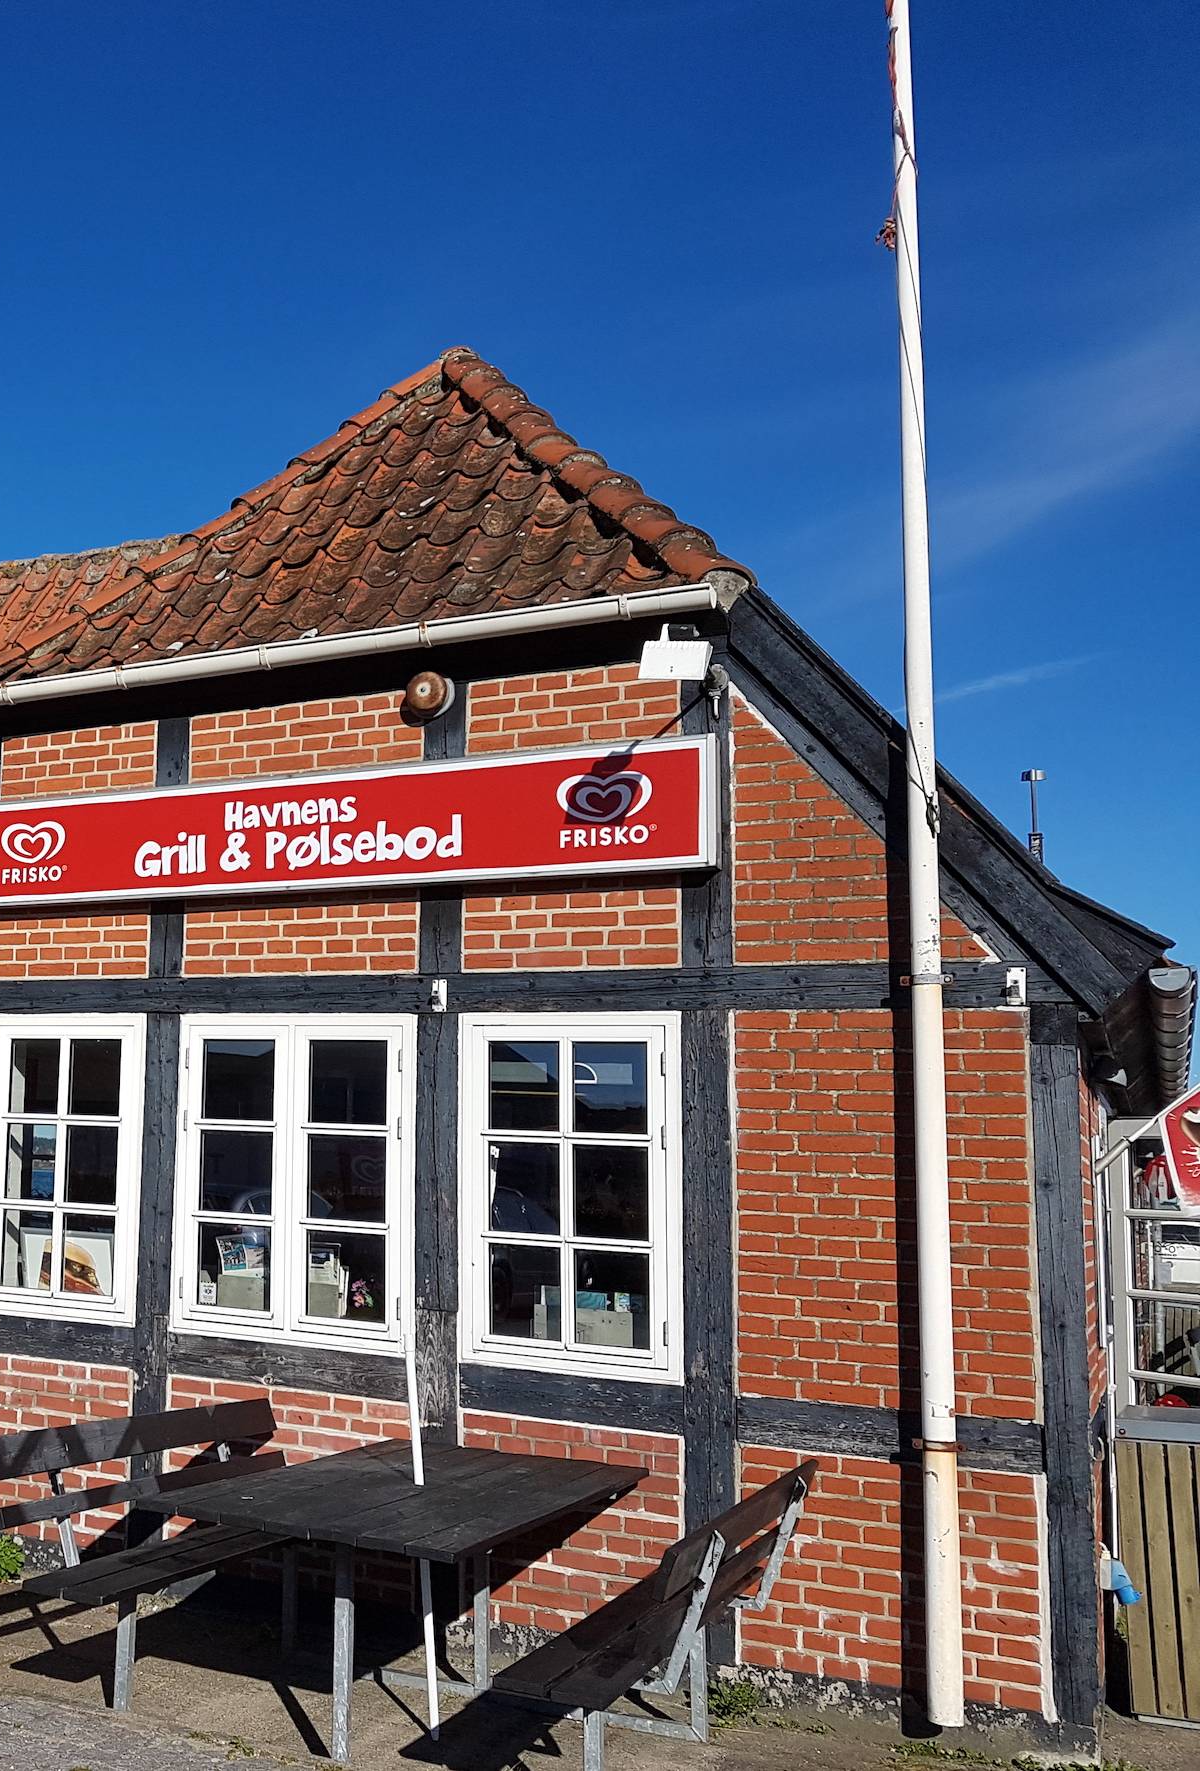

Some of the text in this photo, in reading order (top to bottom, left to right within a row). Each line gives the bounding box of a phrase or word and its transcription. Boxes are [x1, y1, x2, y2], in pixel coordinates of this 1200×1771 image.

[223, 795, 357, 831] Havnens
[134, 813, 463, 878] Grill & Pølsebod
[560, 824, 649, 849] FRISKO
[1, 865, 62, 885] FRISKO
